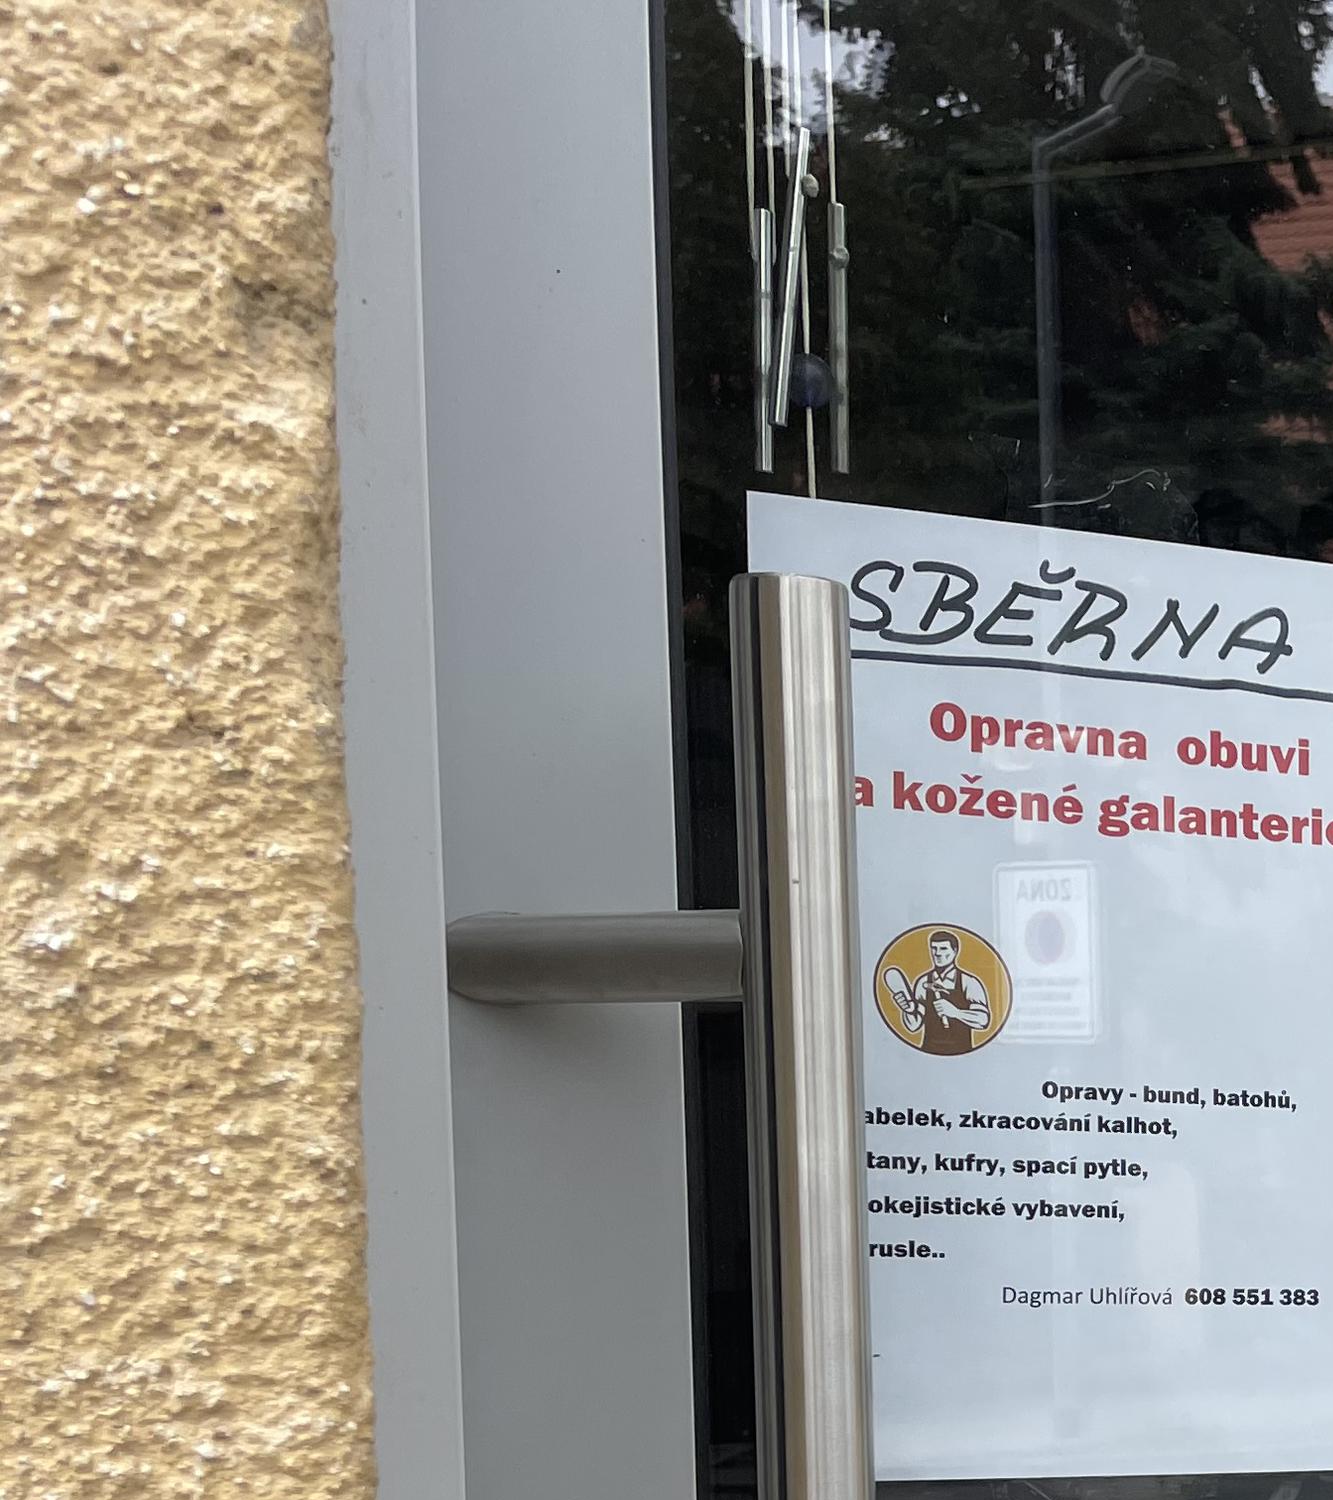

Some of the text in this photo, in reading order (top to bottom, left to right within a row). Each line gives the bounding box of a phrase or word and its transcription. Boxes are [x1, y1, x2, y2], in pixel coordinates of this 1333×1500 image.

[849, 558, 1294, 675] SBĚRNA
[929, 702, 1310, 776] Opravna obuvi
[855, 775, 874, 808] a
[892, 770, 1084, 825] kožené
[1041, 1080, 1124, 1106] Opravy
[1143, 1085, 1206, 1109] bund,
[1213, 1088, 1297, 1113] batohů,
[865, 1107, 1178, 1140] abelek, zkracování kalhot,
[866, 1151, 1148, 1181] tany, kufry, spací pytle,
[868, 1195, 1125, 1223] okejistické vybavení,
[869, 1240, 945, 1258] rusle..
[1002, 1286, 1320, 1309] Dagmar Uhlířová 608 551 383
